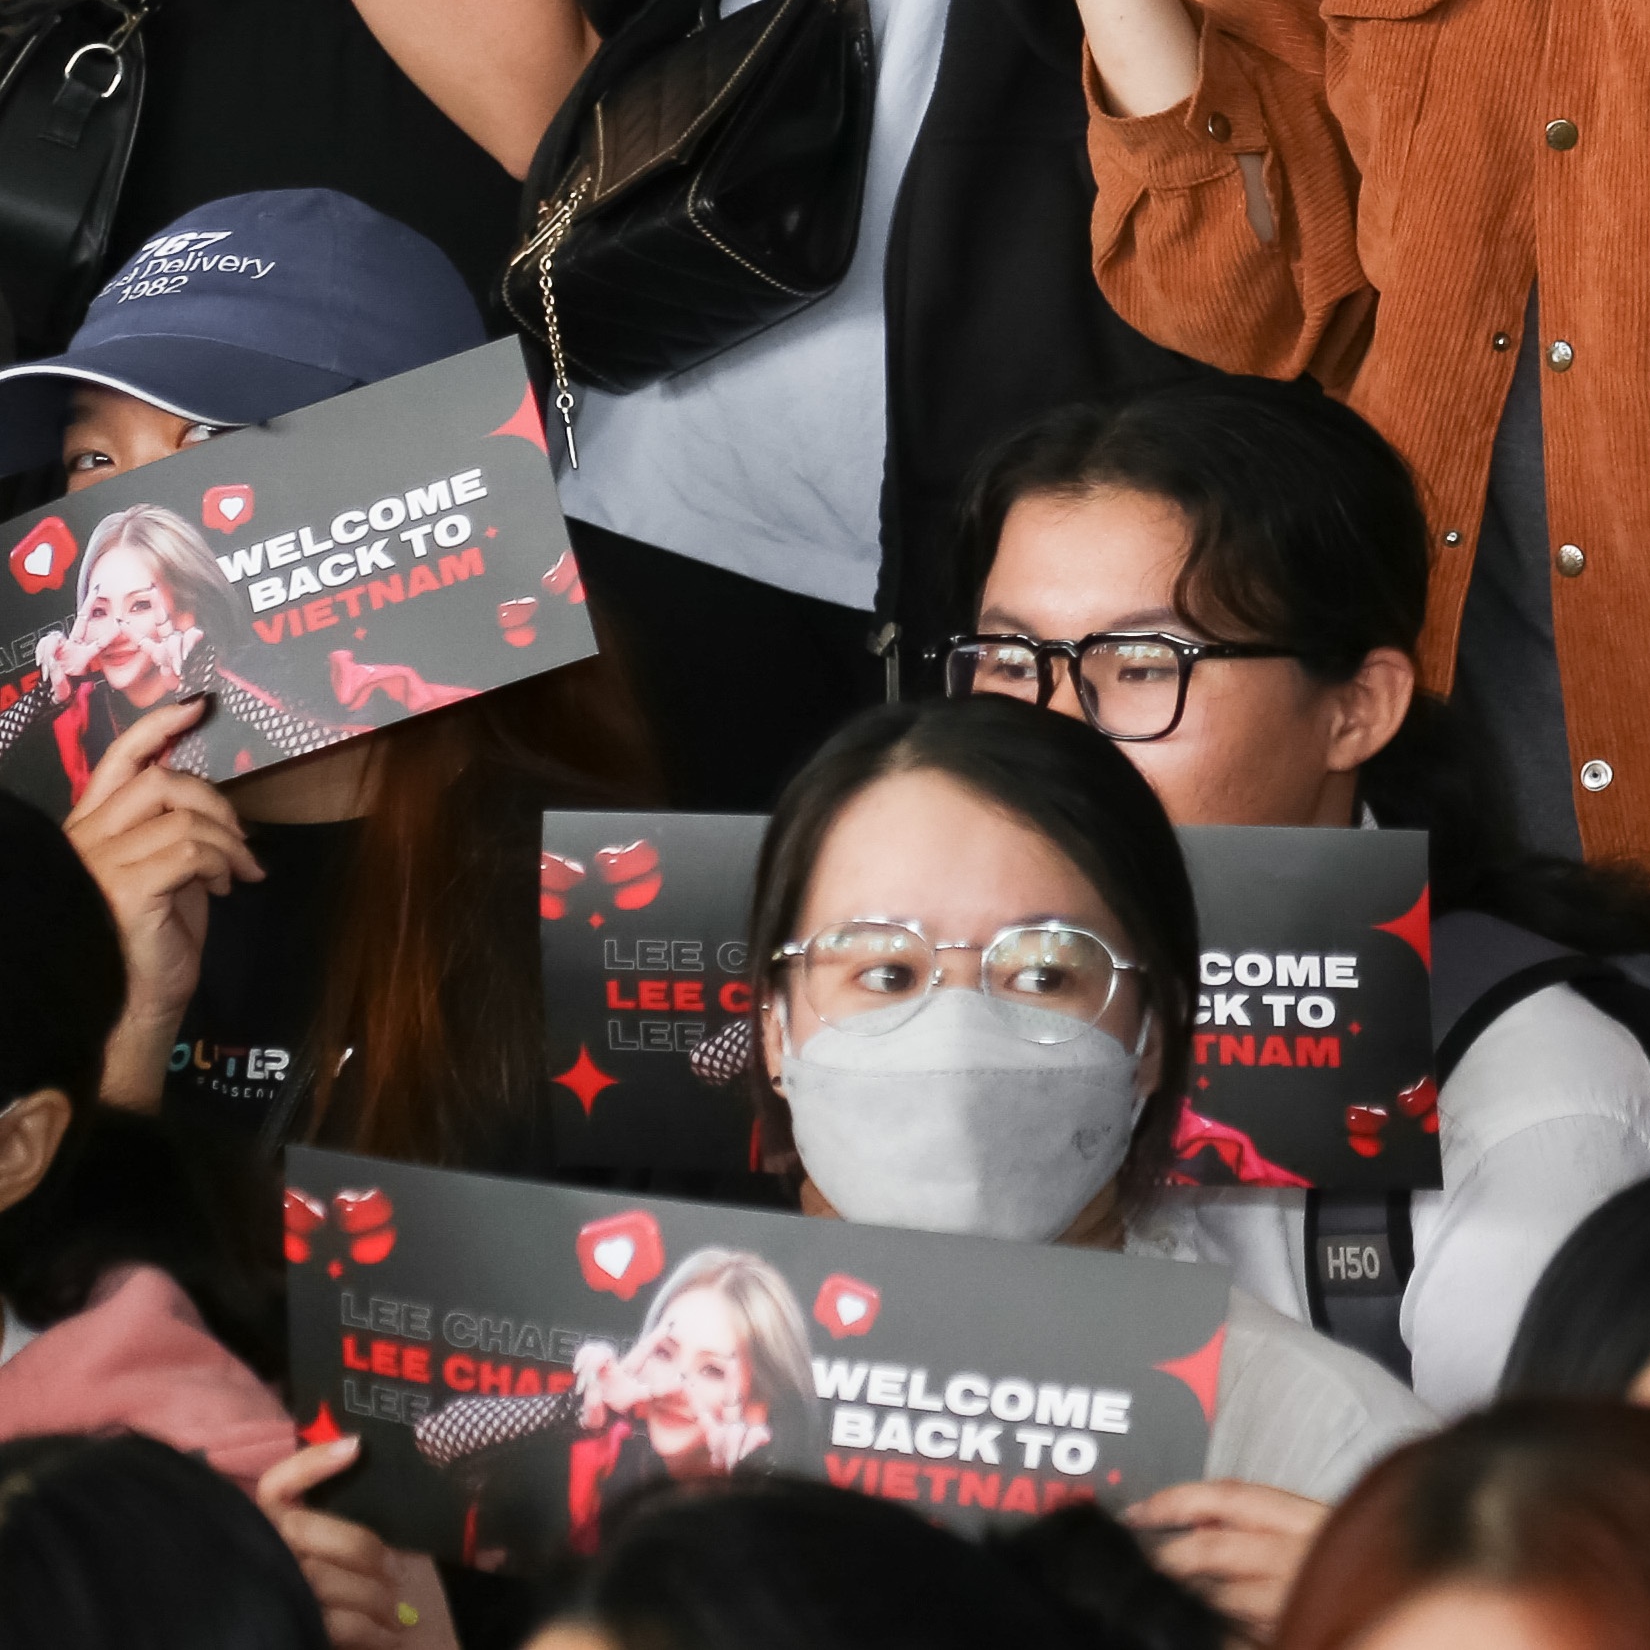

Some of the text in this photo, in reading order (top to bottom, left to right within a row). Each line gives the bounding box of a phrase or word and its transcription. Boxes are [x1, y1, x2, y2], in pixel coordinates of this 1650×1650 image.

[140, 251, 276, 280] Delivery
[116, 275, 189, 305] 1982
[215, 467, 488, 584] WELCOME
[247, 513, 472, 613] BACK TO
[252, 546, 486, 644] VIETNAM
[604, 939, 704, 972] LEE
[1198, 952, 1360, 989] COME
[606, 979, 706, 1011] LEE
[1261, 994, 1337, 1029] TO
[1194, 1033, 1342, 1069] TNAM
[1327, 1246, 1380, 1280] H50
[341, 1293, 432, 1340] LEE
[343, 1335, 432, 1384] LEE
[811, 1358, 1132, 1434] WELCOME
[831, 1406, 1099, 1476] BACK TO
